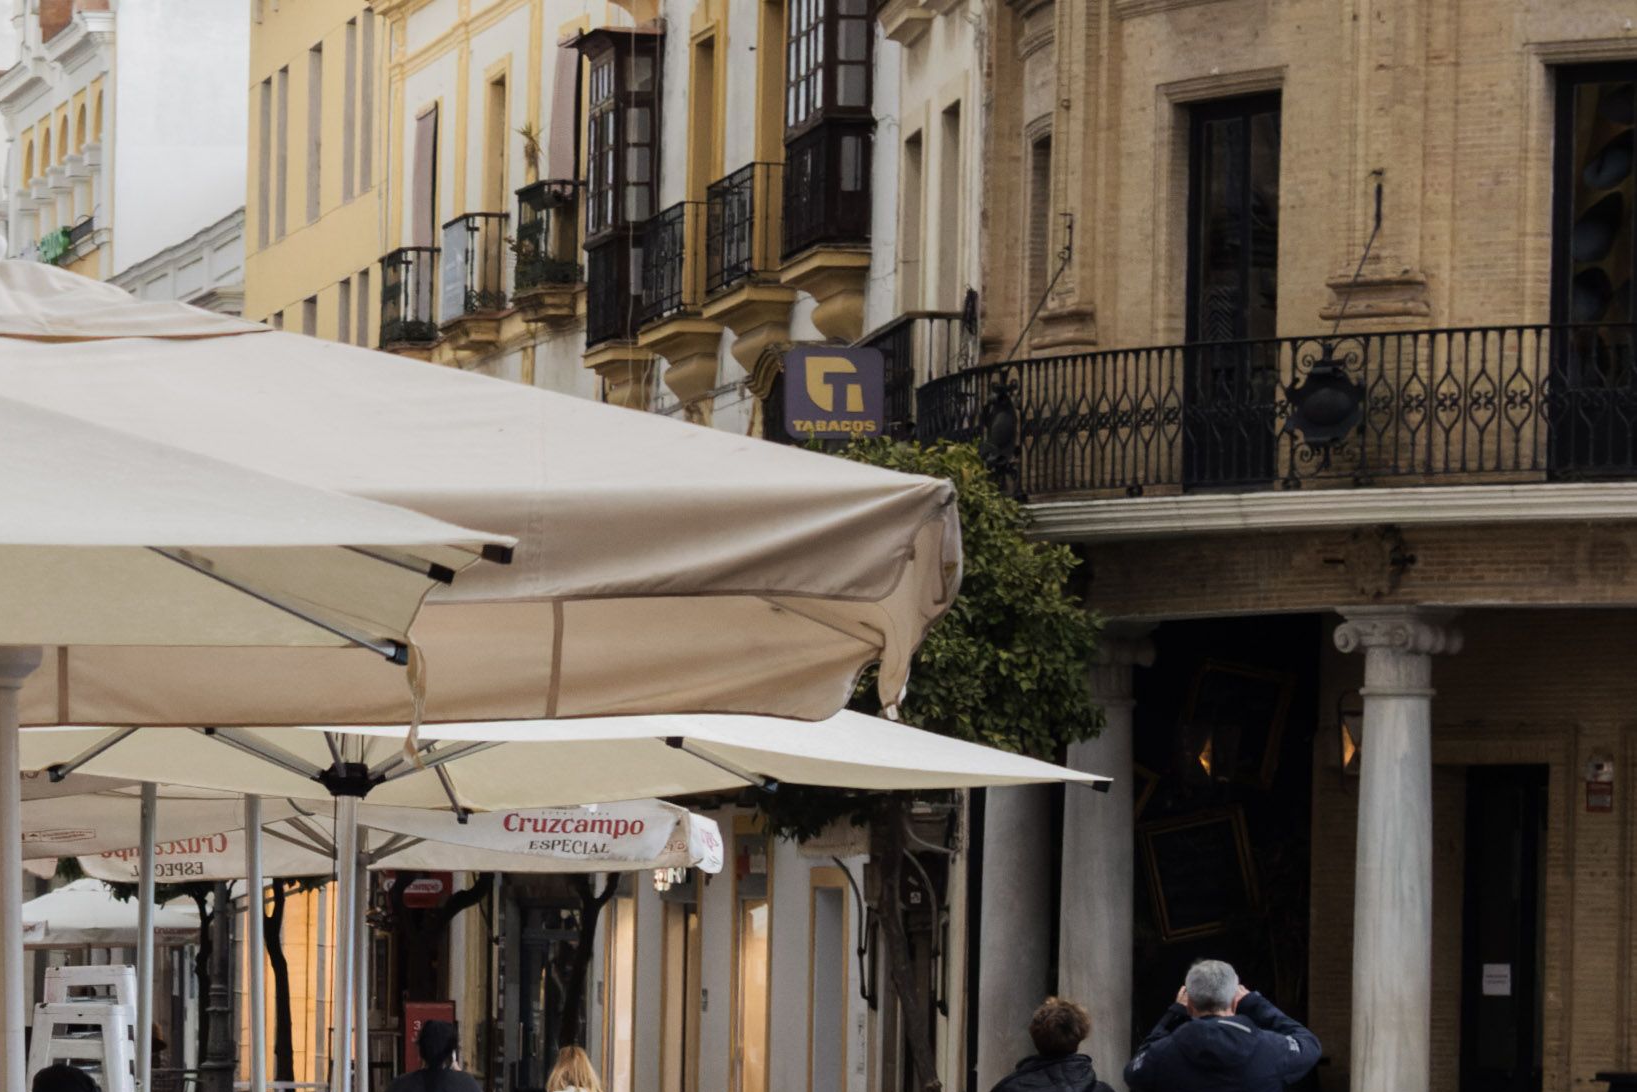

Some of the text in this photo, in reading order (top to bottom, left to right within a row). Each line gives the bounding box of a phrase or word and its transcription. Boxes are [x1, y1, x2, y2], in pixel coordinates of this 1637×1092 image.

[793, 420, 876, 433] TABACOS
[503, 812, 645, 839] Cruzcampo
[528, 838, 611, 856] ESPECIAL
